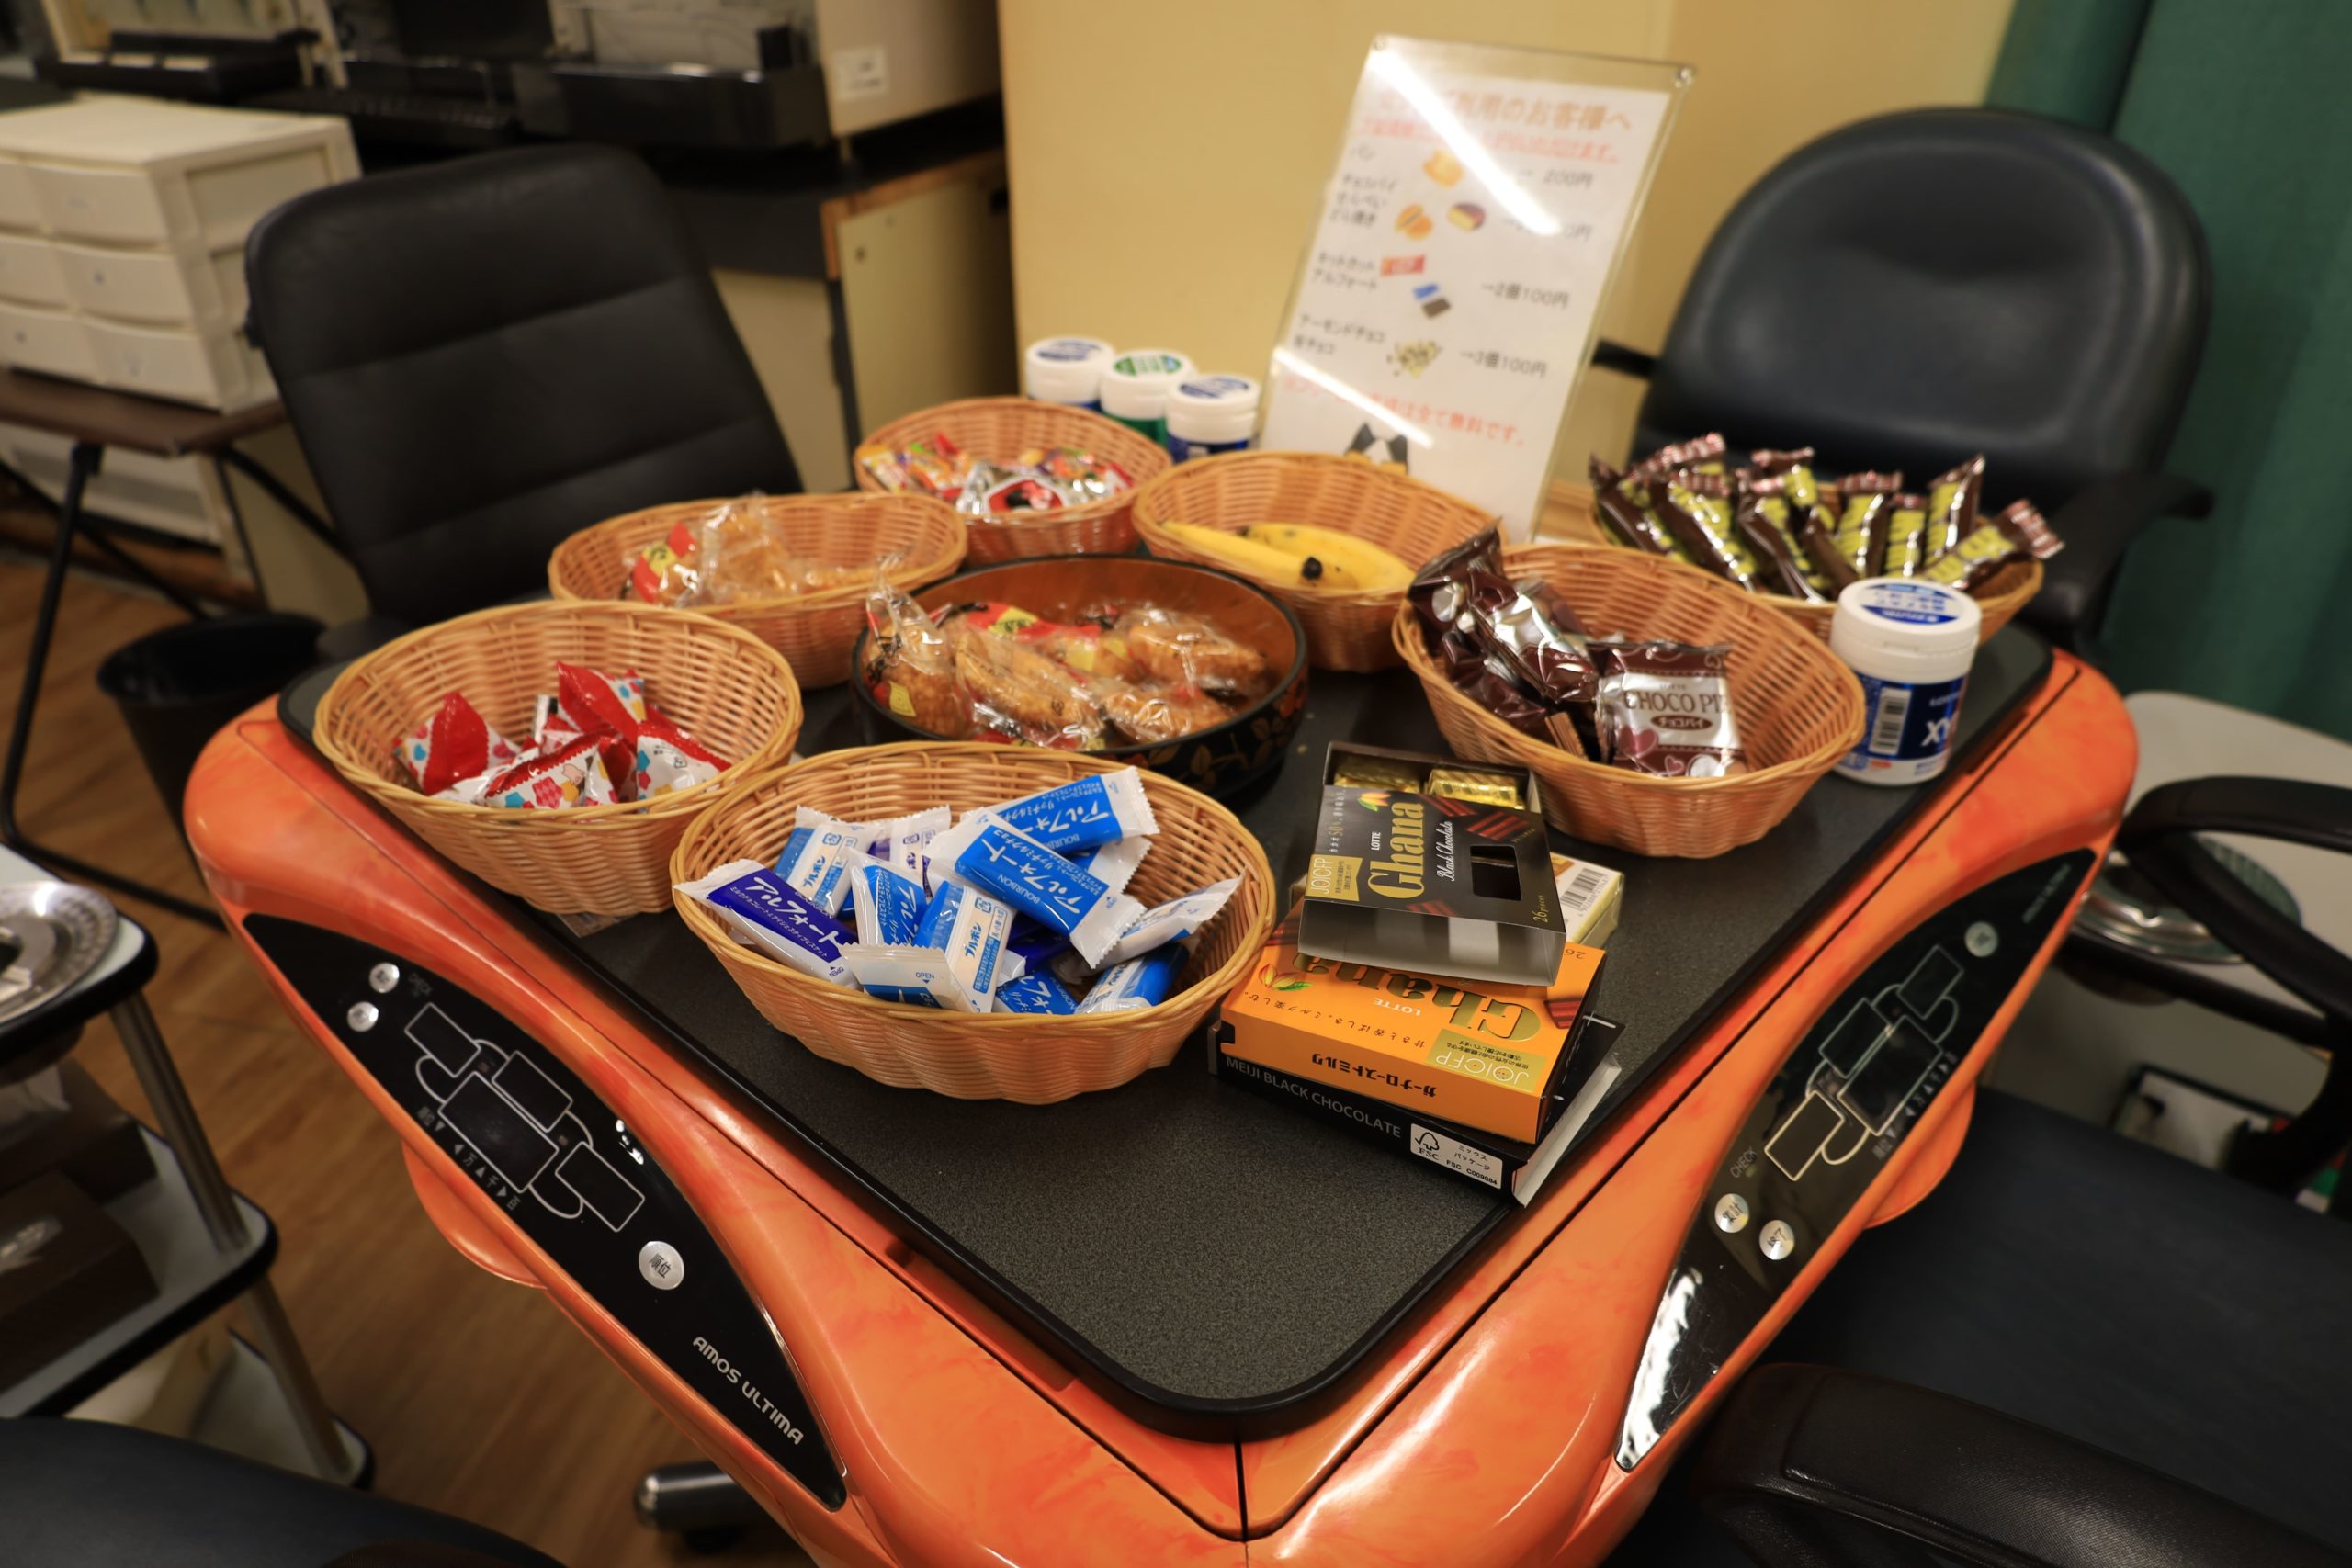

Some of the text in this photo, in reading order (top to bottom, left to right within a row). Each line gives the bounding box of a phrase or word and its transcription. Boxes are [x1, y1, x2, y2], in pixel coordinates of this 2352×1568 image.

[1624, 691, 1696, 714] CHOCO
[1021, 800, 1110, 834] アルフォー
[1368, 801, 1425, 899] Ghana
[1371, 831, 1382, 851] LOTTE
[1436, 820, 1456, 882] Black Chocolate
[981, 838, 1083, 914] アルフォート
[997, 874, 1041, 904] BOURBON
[1310, 857, 1333, 895] JOICFP
[745, 876, 841, 945] アルフォート
[965, 921, 983, 959] ブルボン
[915, 971, 935, 980] OPEN
[1292, 952, 1542, 1043] Ghana
[1373, 998, 1422, 1017] LOTTE
[1311, 1053, 1438, 1098] ガーナローストミルク
[1435, 1051, 1530, 1086] JOICFP
[1226, 1056, 1402, 1139] MEIJI BLACK CHOCOLATE
[1418, 1147, 1440, 1162] FSC
[1445, 1159, 1463, 1171] FSC
[1457, 1144, 1488, 1162] ミックス
[1729, 1145, 1758, 1179] CHECK
[648, 1252, 673, 1280] 順位
[692, 1336, 805, 1446] AMOS ULTIMA
